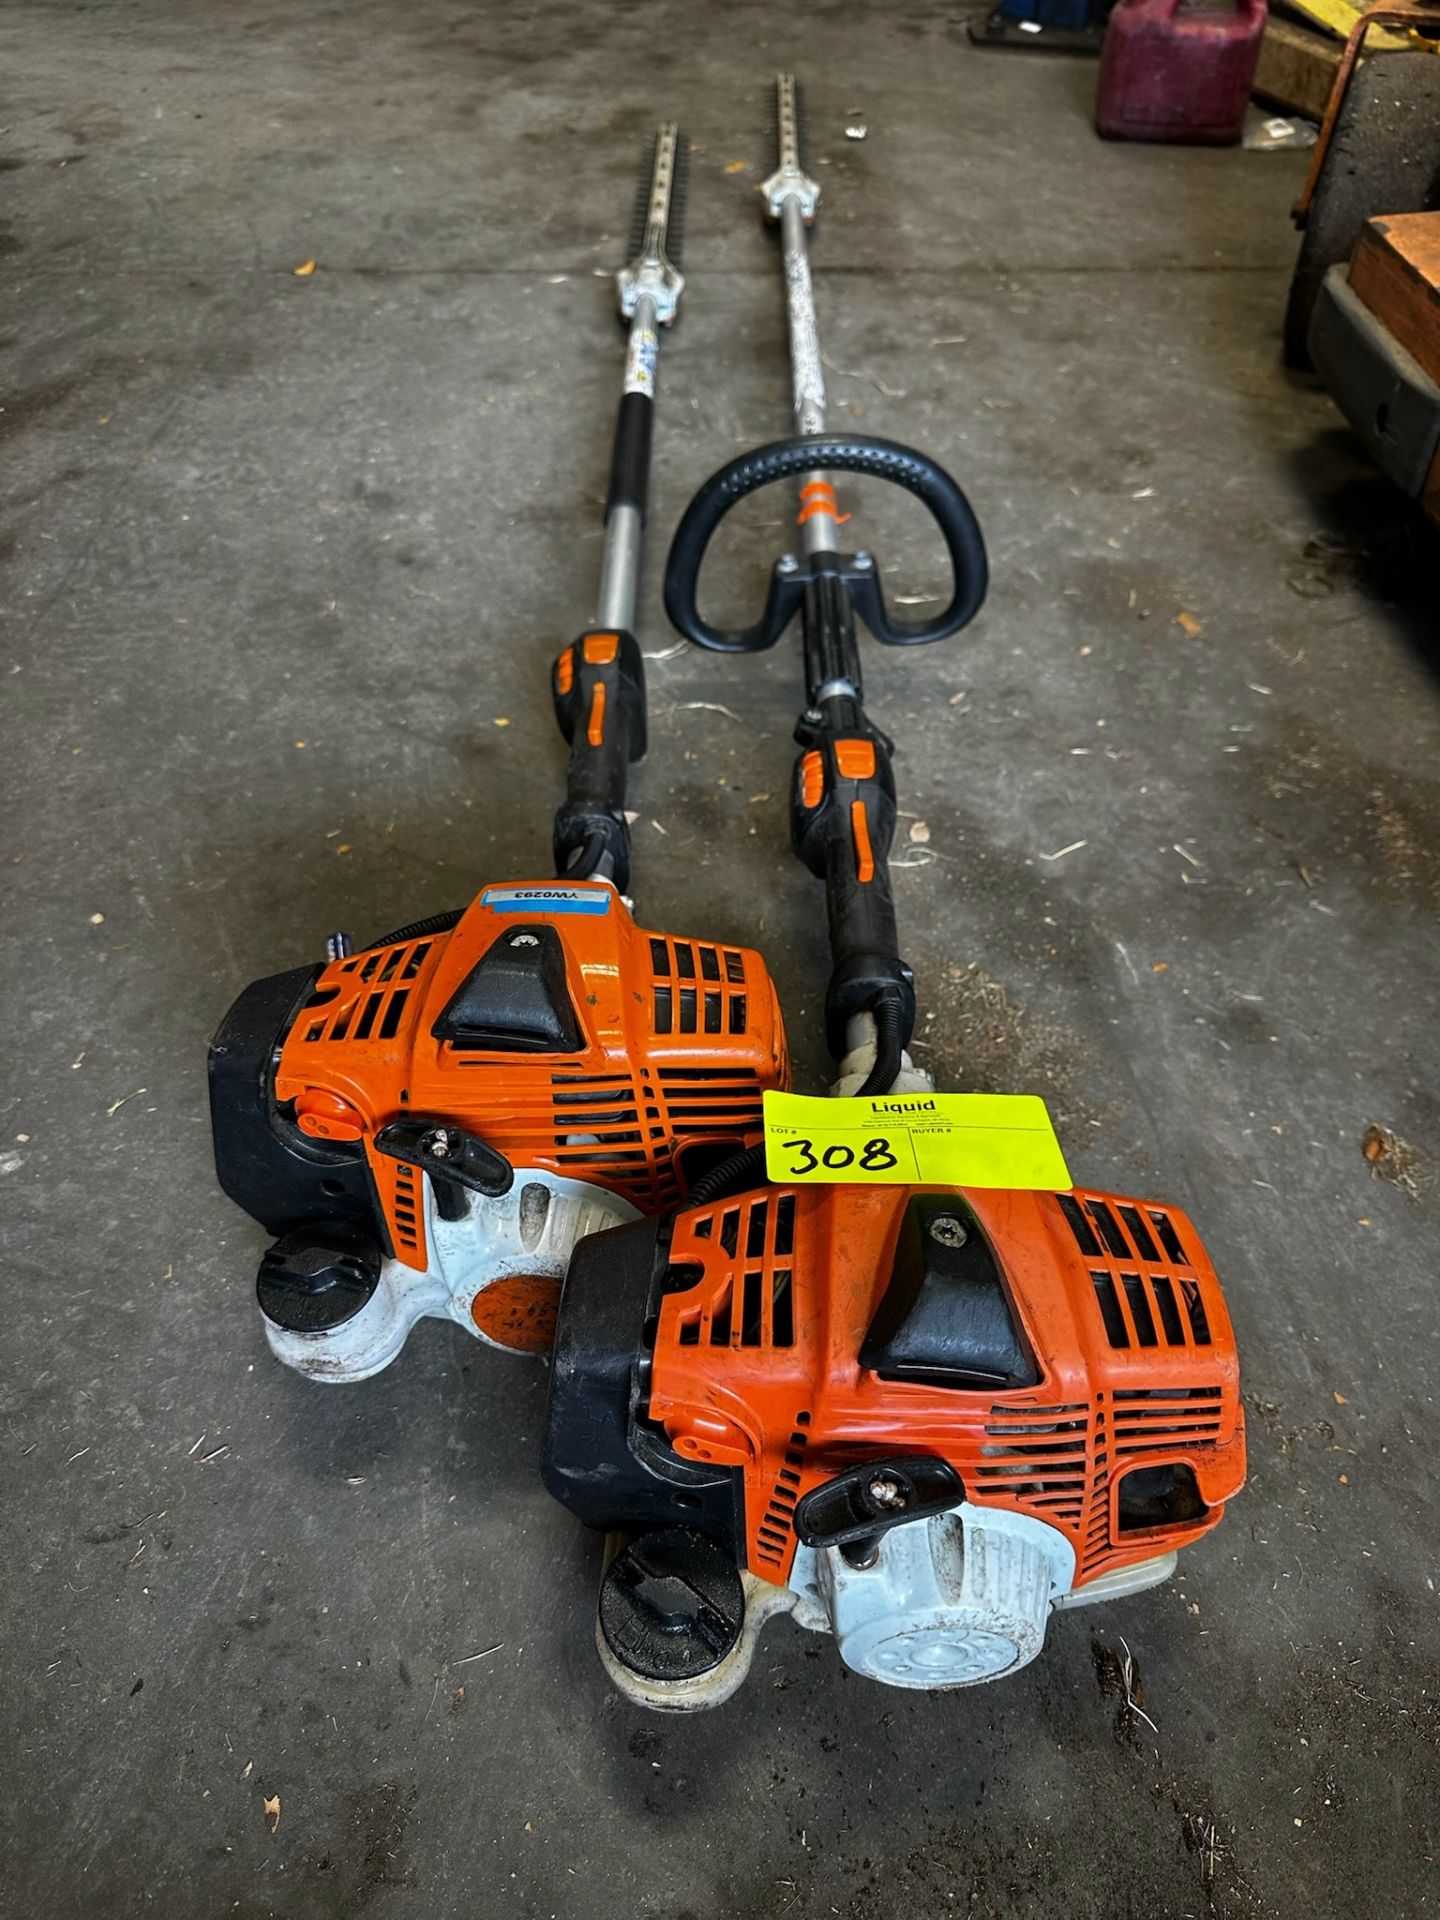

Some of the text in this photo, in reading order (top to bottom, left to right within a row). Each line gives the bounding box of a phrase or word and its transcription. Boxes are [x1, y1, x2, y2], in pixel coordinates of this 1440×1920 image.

[871, 1100, 936, 1114] Liquid
[770, 1127, 790, 1135] LOT
[781, 1137, 898, 1175] 308
